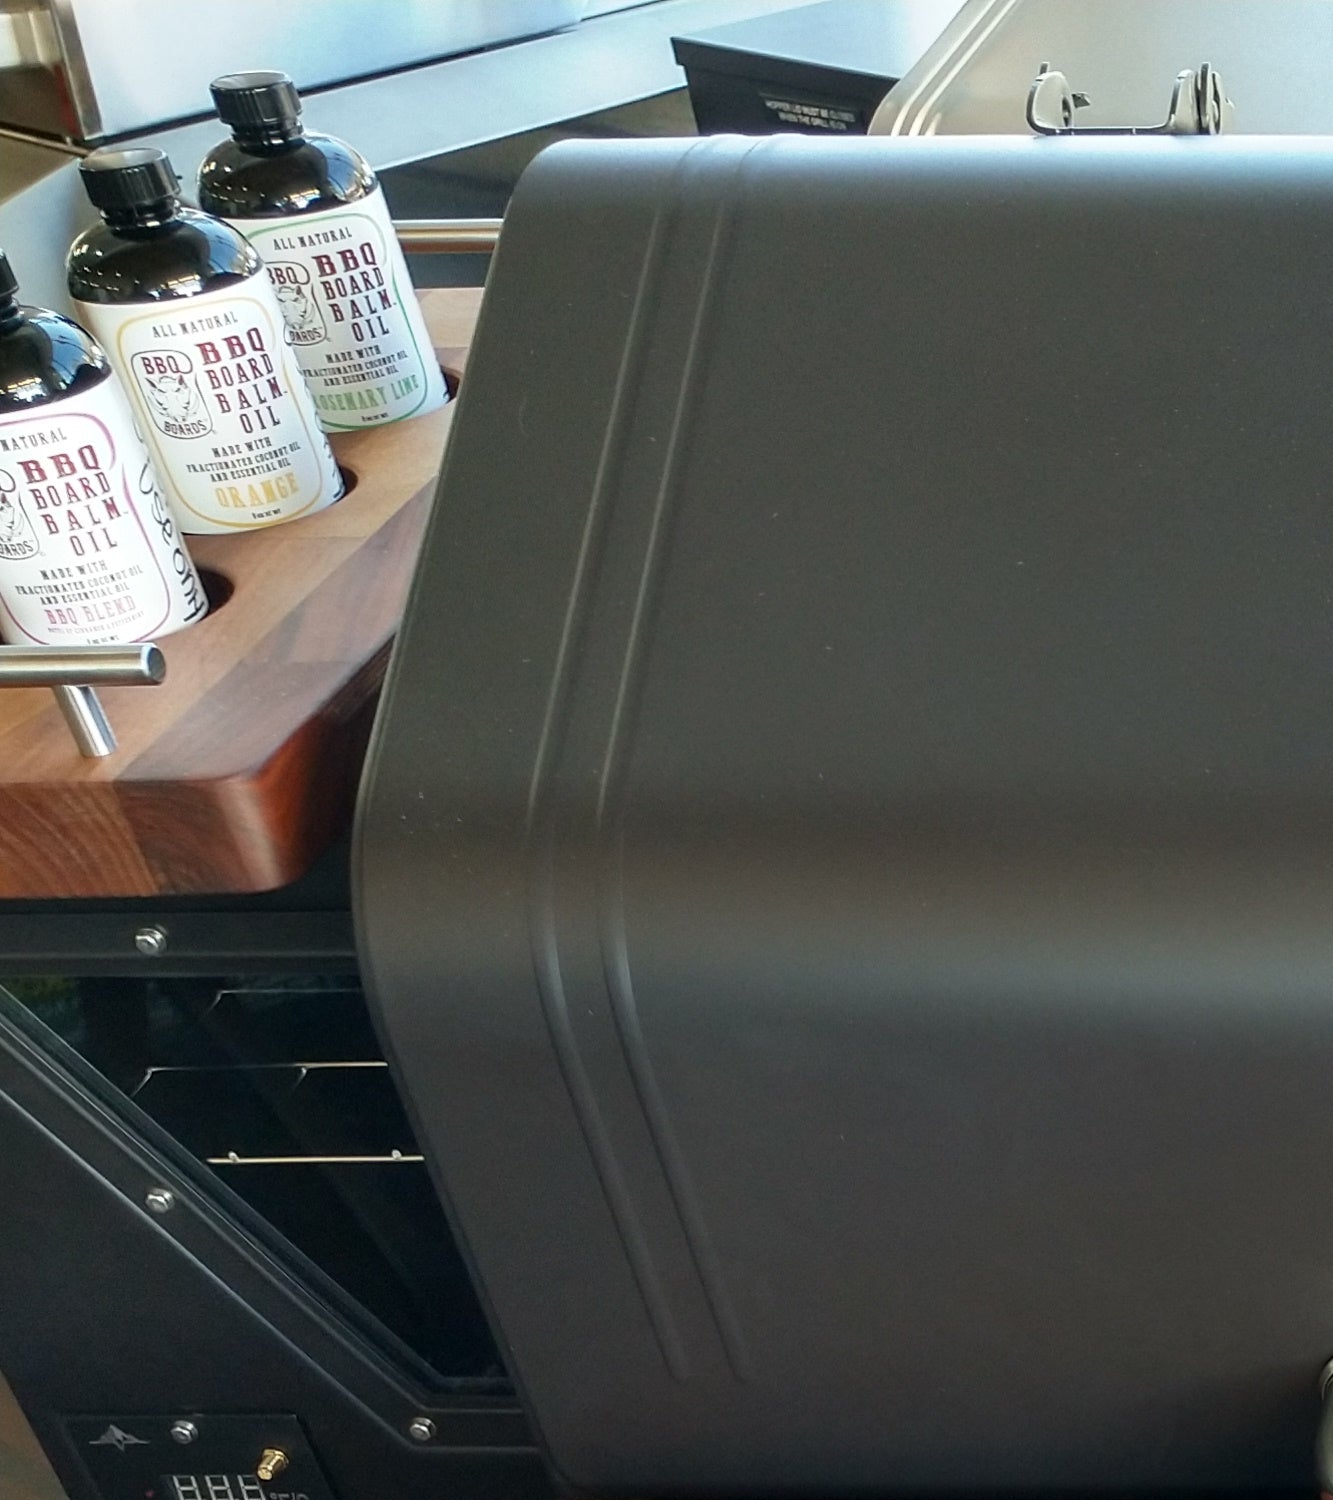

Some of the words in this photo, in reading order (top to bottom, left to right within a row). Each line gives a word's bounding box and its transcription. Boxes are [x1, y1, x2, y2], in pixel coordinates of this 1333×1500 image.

[273, 238, 295, 250] ALL
[298, 227, 352, 247] NATURAL
[312, 242, 377, 278] BBQ
[320, 267, 385, 300] BOARD
[329, 289, 392, 323] BALM
[152, 325, 178, 338] ALL
[179, 311, 238, 335] NATURAL
[352, 316, 389, 342] OIL
[195, 327, 266, 366] BBQ
[325, 351, 354, 363] MADE
[355, 345, 381, 358] WITH
[141, 356, 181, 375] BBQ
[205, 353, 274, 390] BOARD
[215, 376, 283, 414] BALM
[315, 387, 387, 411] OSEMARY
[391, 374, 419, 400] LIME
[164, 420, 207, 436] BOARDS
[240, 406, 281, 434] OIL
[0, 428, 67, 452] NATURAL
[211, 445, 243, 458] MADE
[244, 436, 272, 452] WITH
[16, 445, 101, 484] BBQ
[255, 446, 288, 465] COCONUT
[29, 472, 111, 510] BOARD
[214, 472, 299, 508] ORANGE
[41, 496, 121, 535] BALM
[70, 527, 118, 556] OIL
[40, 567, 73, 580] MADE
[76, 560, 108, 575] WITH
[44, 608, 79, 626] BBQ
[82, 595, 136, 622] BLEND
